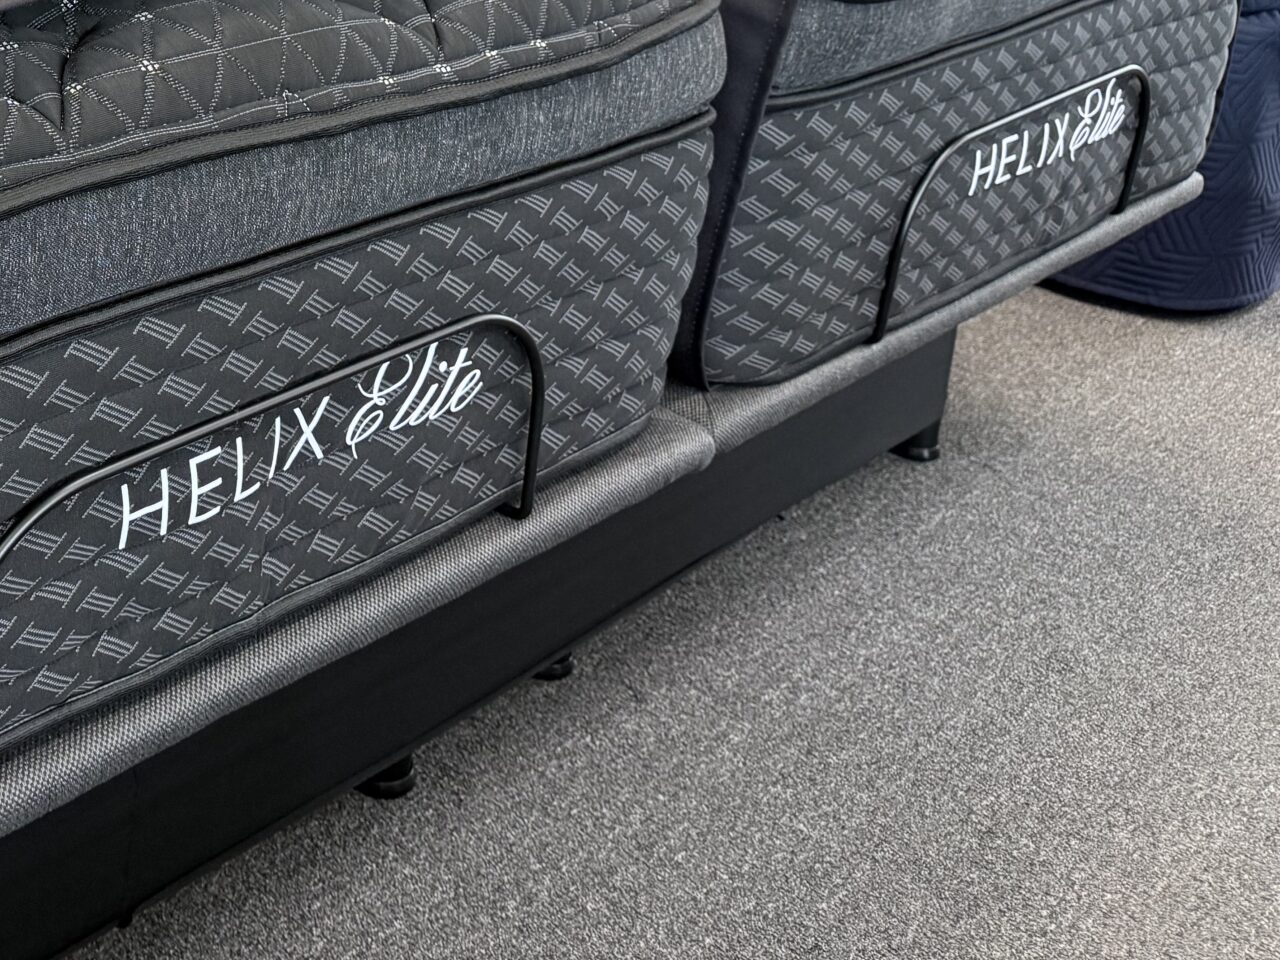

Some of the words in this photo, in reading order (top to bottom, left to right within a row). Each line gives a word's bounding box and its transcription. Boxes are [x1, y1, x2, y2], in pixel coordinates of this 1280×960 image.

[968, 112, 1070, 197] HELIX
[1069, 77, 1126, 162] Elite
[119, 396, 330, 550] HELIX
[345, 341, 483, 460] Elite
